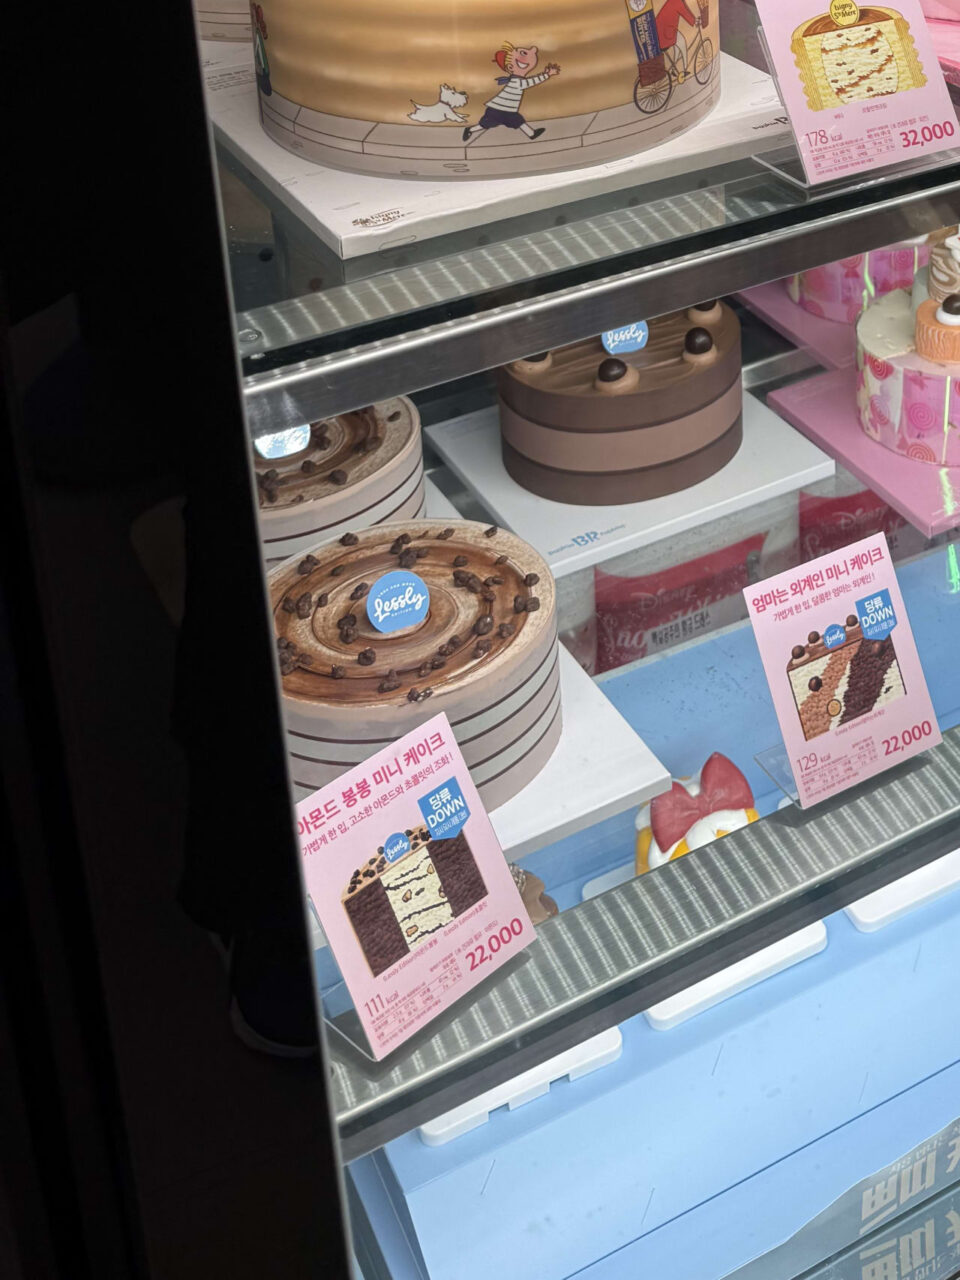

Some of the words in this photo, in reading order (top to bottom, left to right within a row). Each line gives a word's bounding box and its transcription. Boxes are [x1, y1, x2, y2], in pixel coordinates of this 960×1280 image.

[805, 129, 829, 147] 178
[900, 121, 955, 148] 32,000
[572, 531, 601, 548] BR
[752, 588, 790, 614] 엄마는
[790, 572, 825, 599] 외계인
[826, 564, 848, 580] 미니
[850, 546, 885, 571] 케이크
[374, 586, 427, 622] Lessly
[773, 607, 794, 622] 가볍게
[811, 592, 832, 608] 달콤한
[833, 584, 851, 598] 엄마는
[851, 575, 872, 591] 외계인
[864, 596, 884, 612] 당류
[862, 605, 893, 627] DOWN
[882, 720, 933, 757] 22,000
[796, 752, 818, 773] 129
[297, 799, 342, 836] 아몬드
[341, 779, 371, 809] 봉봉
[372, 757, 403, 785] 미니
[403, 732, 445, 766] 케이크
[428, 788, 452, 811] 당류
[302, 834, 328, 857] 가볍게
[328, 828, 337, 839] 한
[349, 806, 373, 826] 고소한
[374, 786, 405, 810] 아몬드와
[405, 764, 434, 791] 초콜릿의
[434, 755, 450, 771] 조화
[427, 795, 465, 828] DOWN
[465, 917, 523, 973] 22,000
[364, 993, 385, 1018] 111
[859, 1150, 937, 1235] 쁘띠
